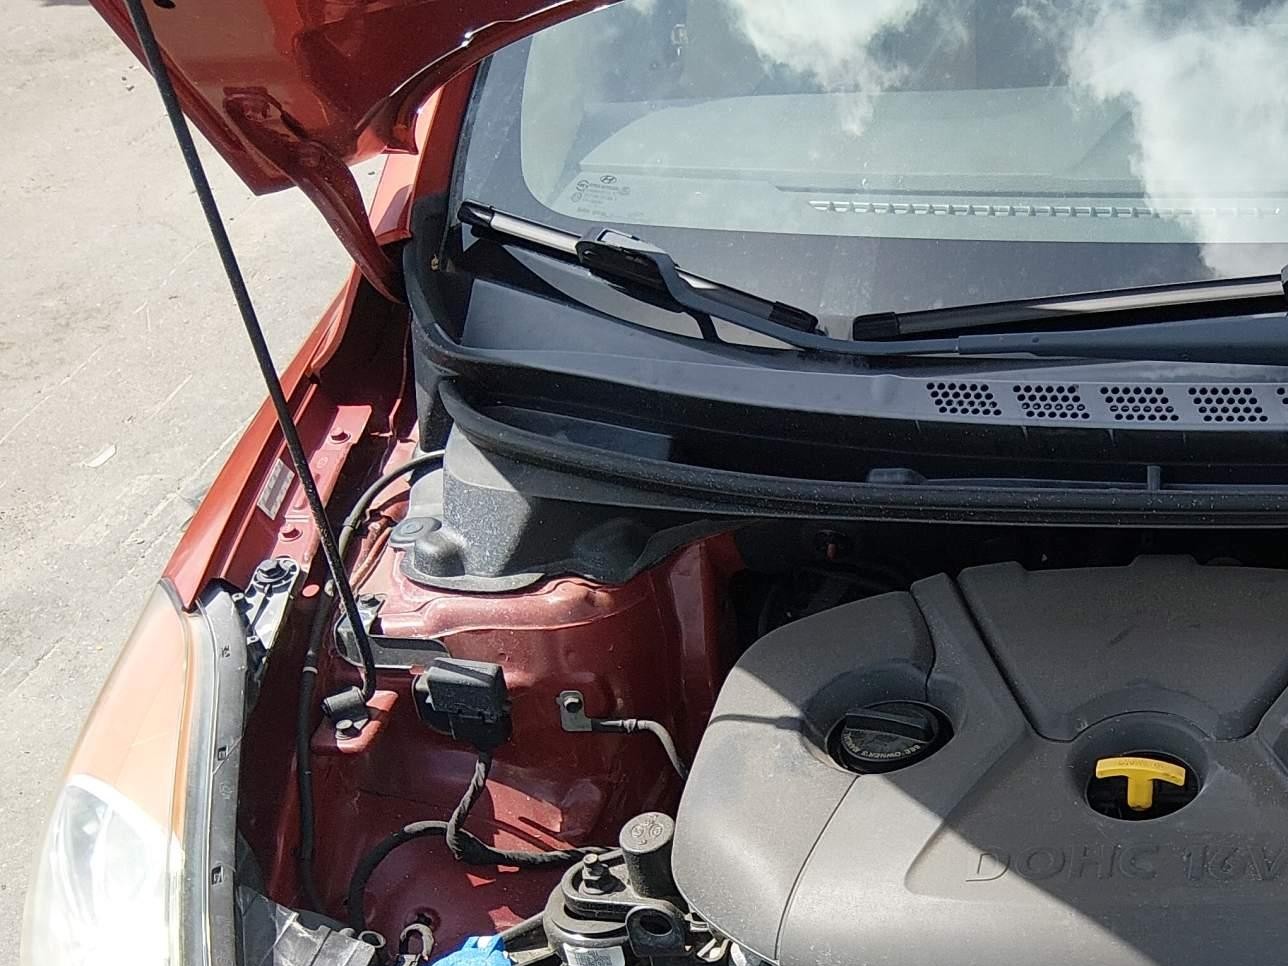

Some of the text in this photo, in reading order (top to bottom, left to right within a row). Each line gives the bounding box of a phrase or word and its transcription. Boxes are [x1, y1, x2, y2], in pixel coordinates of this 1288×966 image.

[862, 750, 902, 759] OWNER'S
[904, 743, 921, 755] SEE
[965, 845, 1159, 883] DOHC
